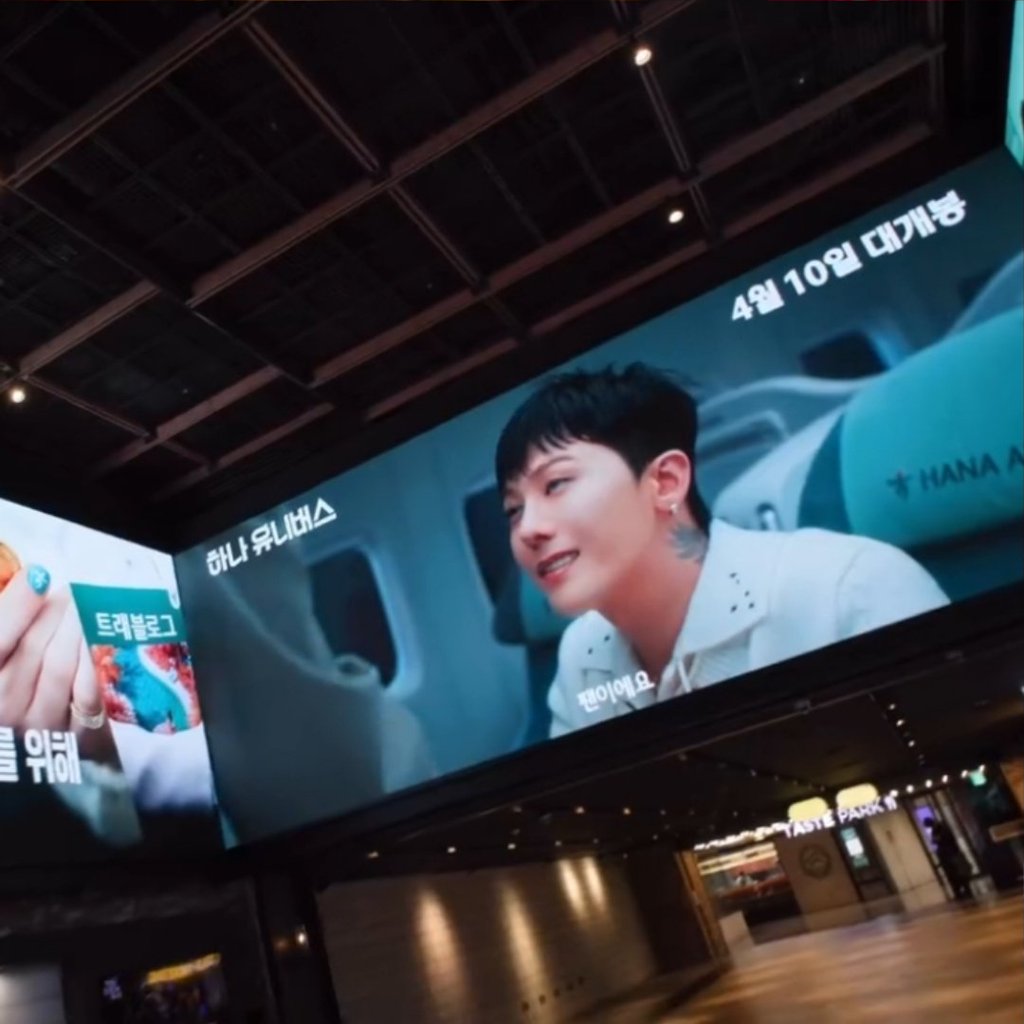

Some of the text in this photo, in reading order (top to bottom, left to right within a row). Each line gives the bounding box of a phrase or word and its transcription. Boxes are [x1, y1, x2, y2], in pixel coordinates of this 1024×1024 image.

[731, 189, 966, 321] 4월 10일 대개봉
[919, 452, 1000, 493] HANA
[206, 496, 338, 577] 하나 유니버스
[577, 669, 656, 713] 팬이에요
[24, 728, 82, 785] 위해
